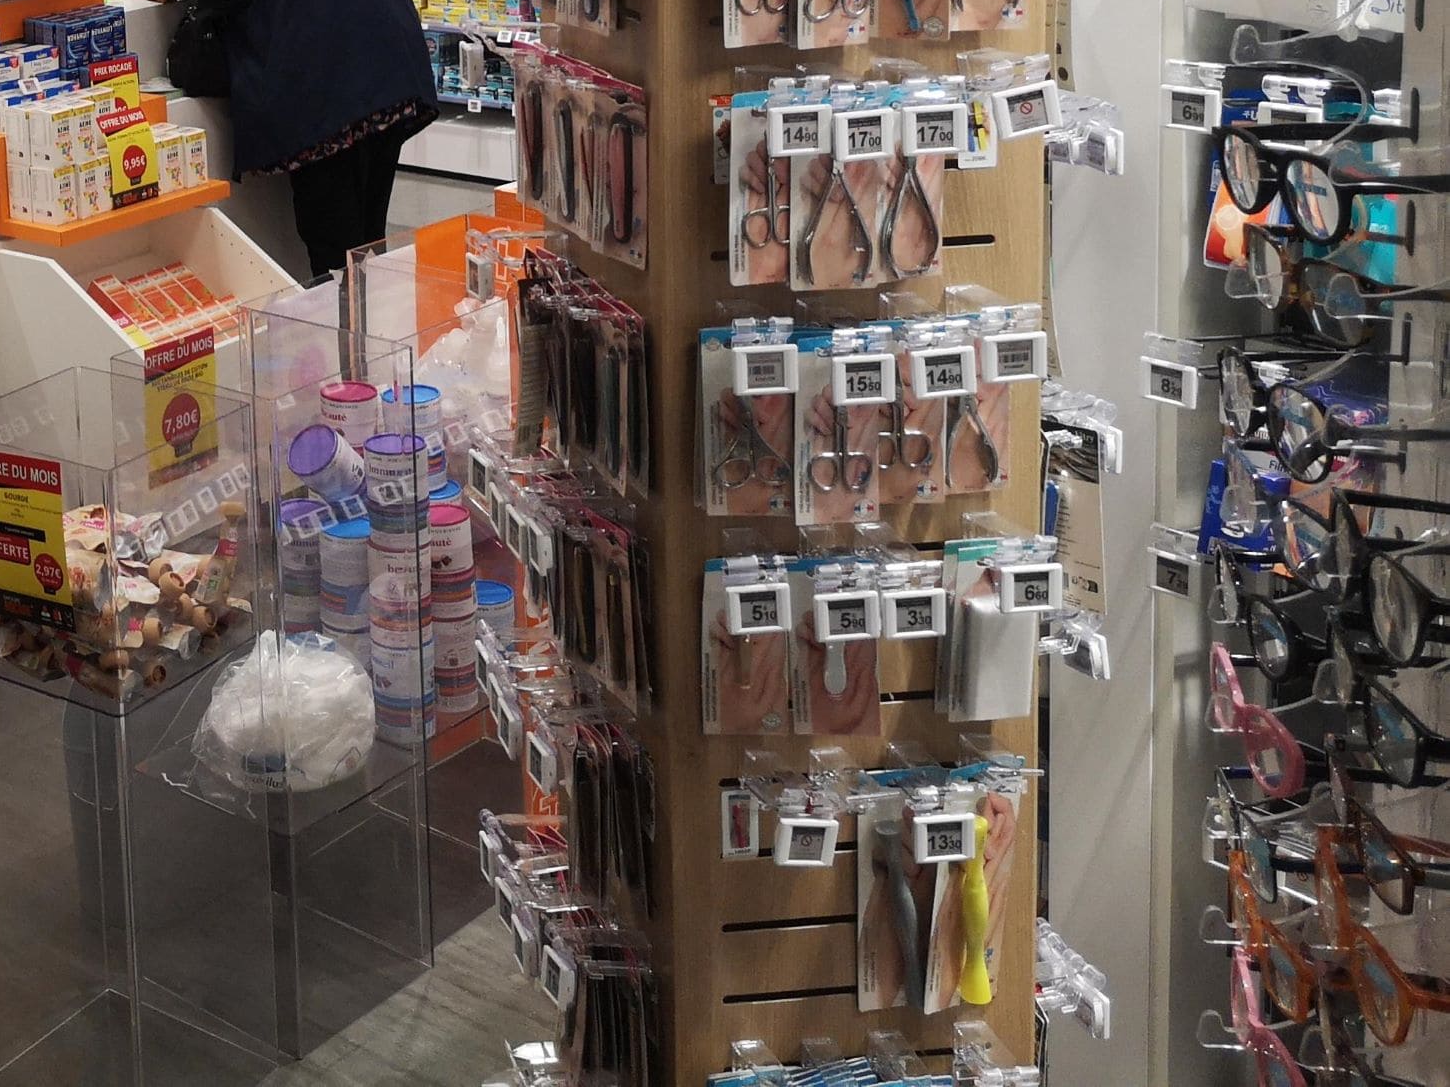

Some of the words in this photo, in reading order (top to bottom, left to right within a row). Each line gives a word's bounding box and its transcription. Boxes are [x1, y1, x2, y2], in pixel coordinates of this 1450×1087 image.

[94, 66, 107, 77] PRIX
[108, 61, 133, 74] ROCADE
[99, 116, 119, 130] OFFRE
[120, 115, 127, 125] DU
[127, 111, 144, 124] MOIS
[124, 156, 146, 172] 9,95€
[144, 351, 175, 370] OFFRE
[177, 345, 190, 359] DU
[192, 335, 214, 354] MOIS
[164, 409, 198, 434] 7,80€
[11, 463, 27, 480] DU
[30, 467, 58, 486] MOIS
[4, 491, 29, 504] GOURDE
[35, 563, 62, 580] 2,97€
